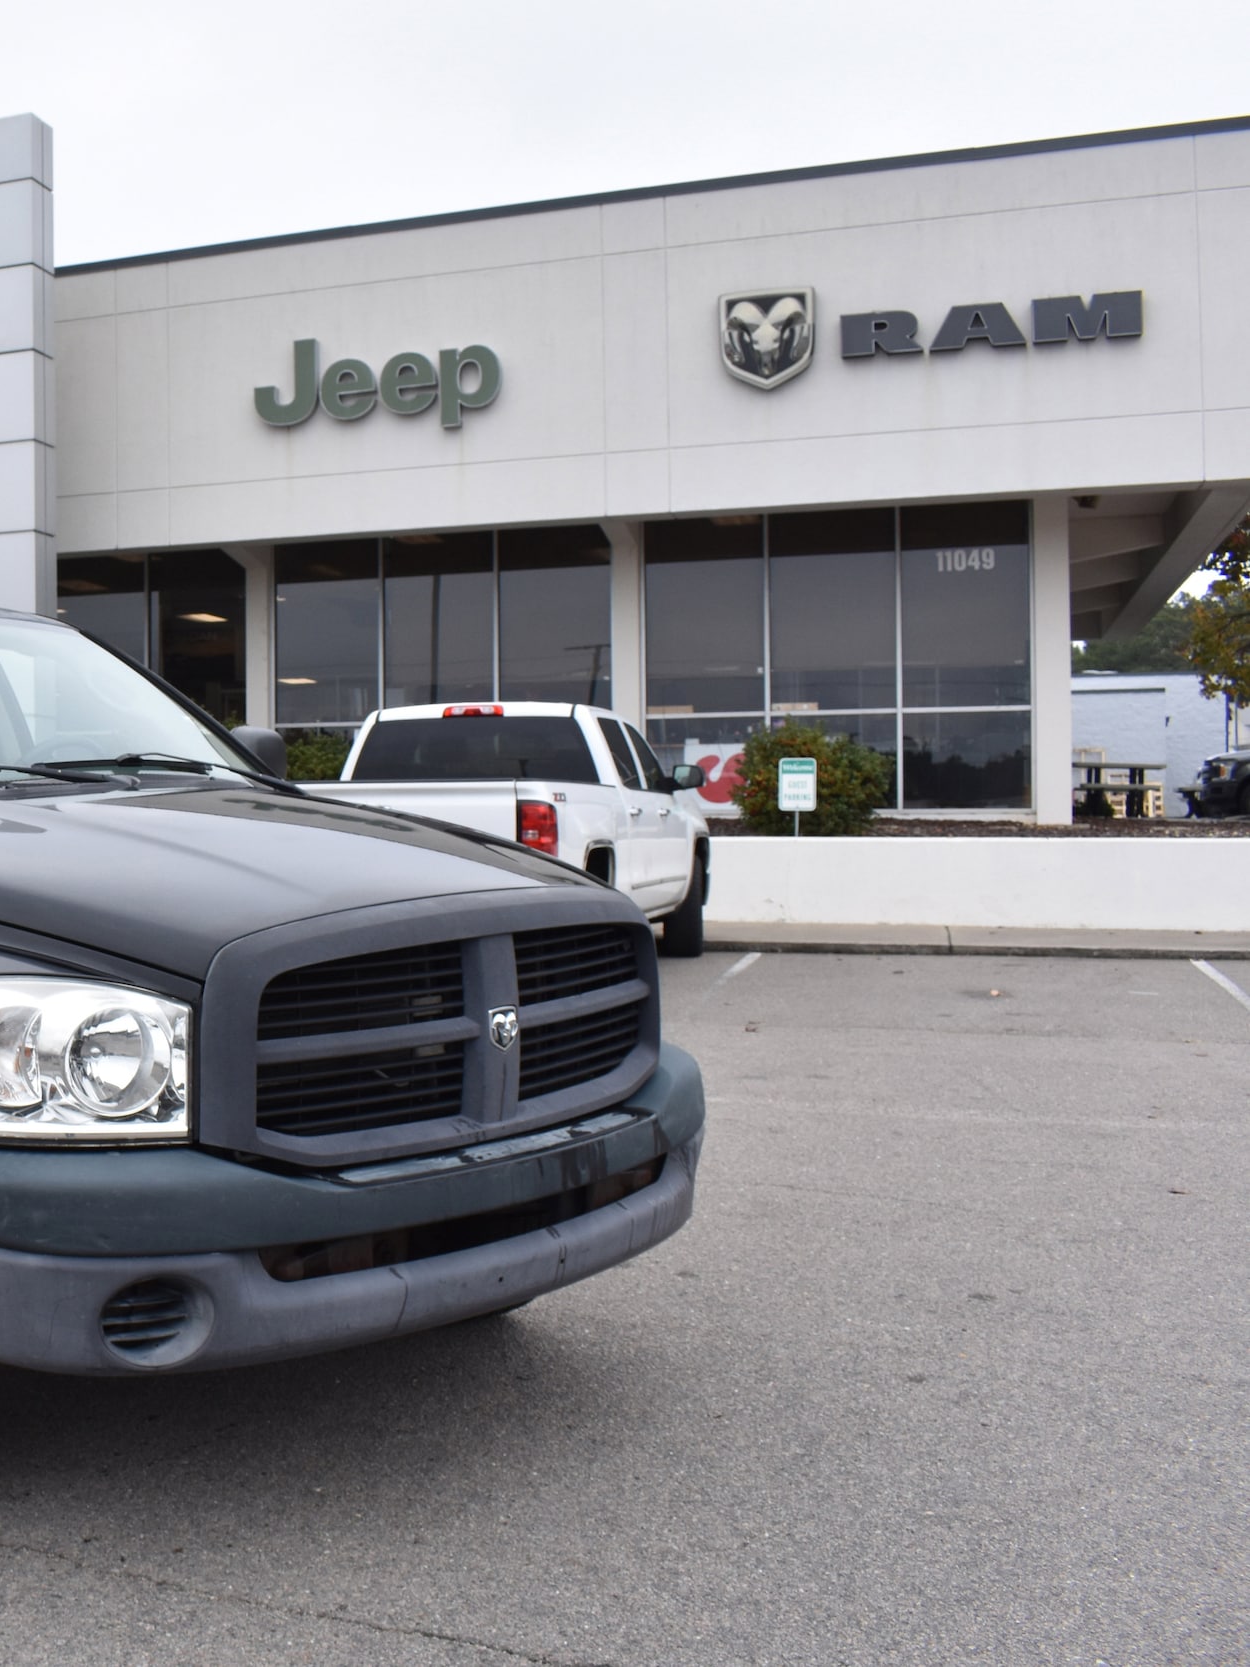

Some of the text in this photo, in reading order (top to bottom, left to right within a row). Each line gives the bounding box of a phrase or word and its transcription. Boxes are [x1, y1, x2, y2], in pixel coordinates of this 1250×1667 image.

[840, 290, 1144, 358] RAM
[254, 338, 502, 428] Jeep
[936, 547, 995, 572] 11049
